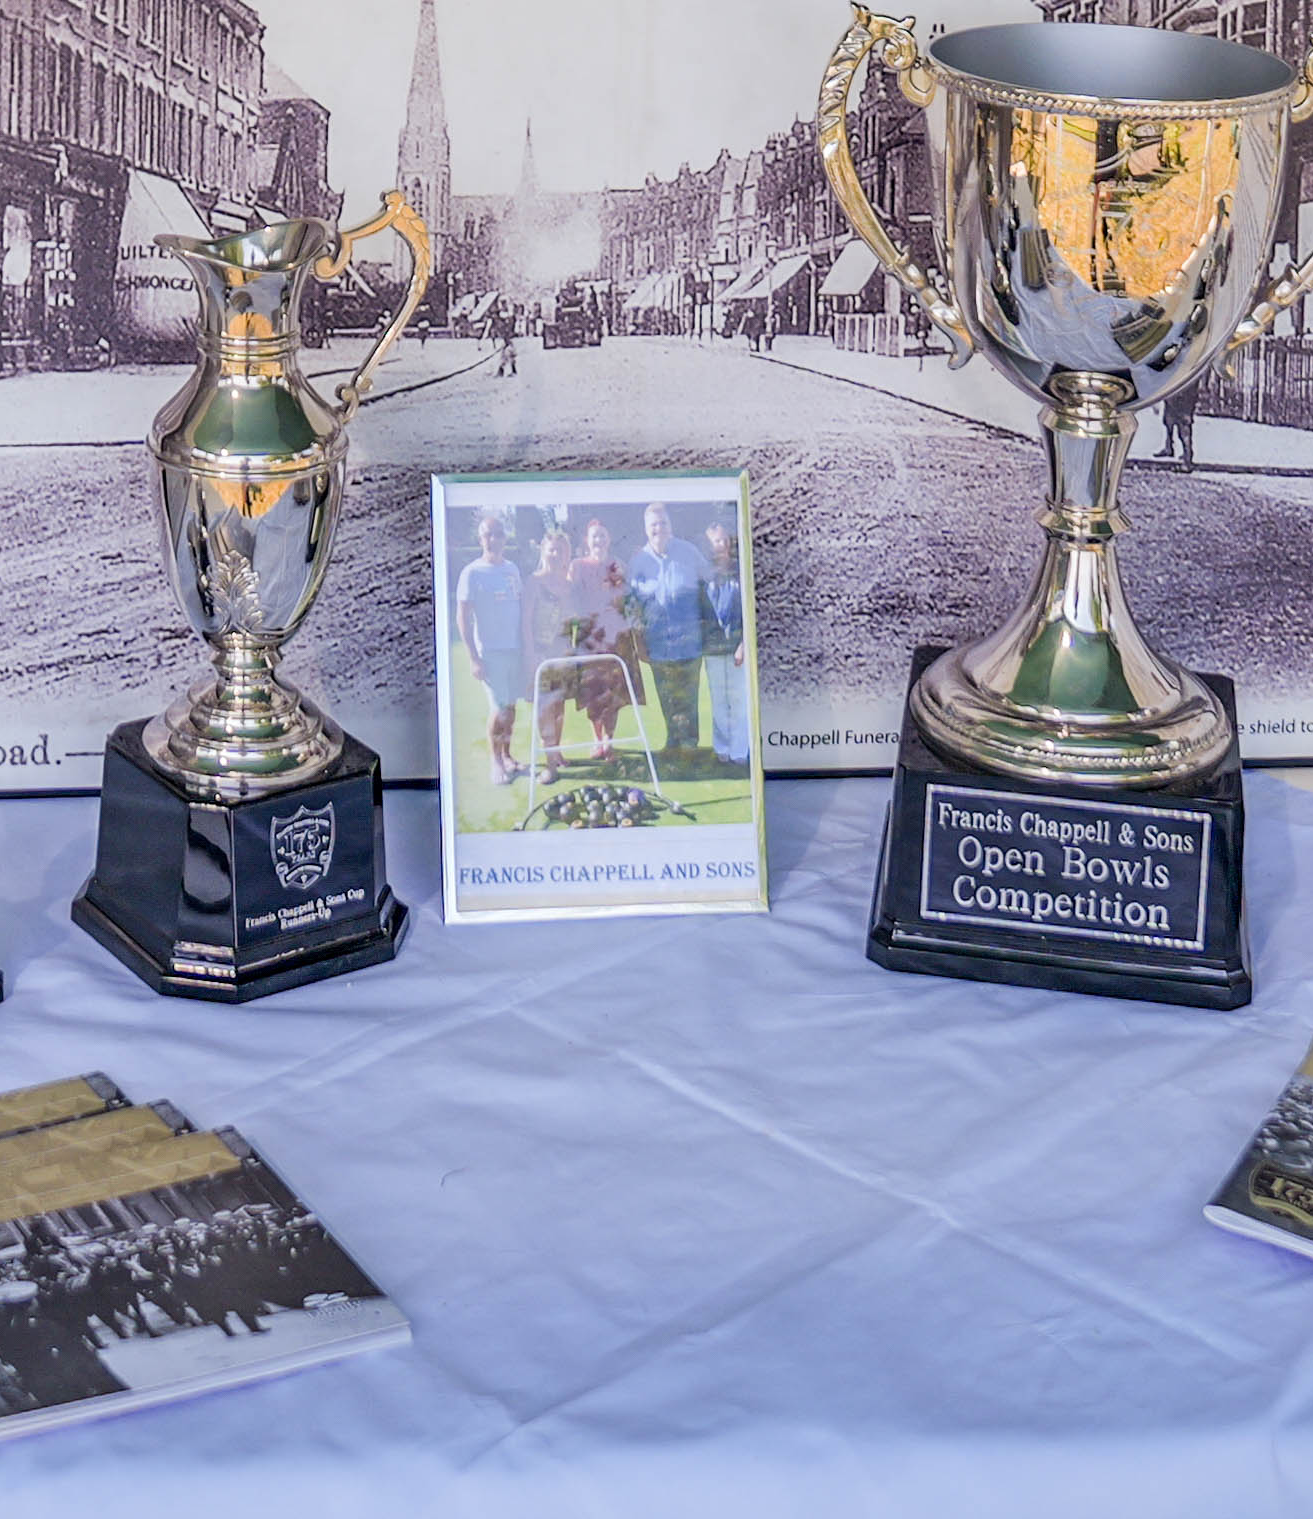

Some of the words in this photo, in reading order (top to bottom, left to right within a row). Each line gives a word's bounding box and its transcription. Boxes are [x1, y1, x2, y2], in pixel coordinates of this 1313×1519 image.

[768, 729, 840, 749] Chappell
[845, 730, 900, 744] Funera
[1249, 719, 1295, 734] shield
[937, 802, 1012, 836] Francis
[1019, 811, 1110, 848] Chappell
[1118, 823, 1135, 847] &
[1144, 825, 1194, 855] Sons
[459, 866, 544, 886] FRANCIS
[550, 864, 654, 882] CHAPPELL
[660, 863, 700, 880] AND
[706, 862, 755, 878] SONS
[957, 836, 1044, 878] Open
[1062, 845, 1170, 890] Bowls
[953, 875, 1171, 932] Competition
